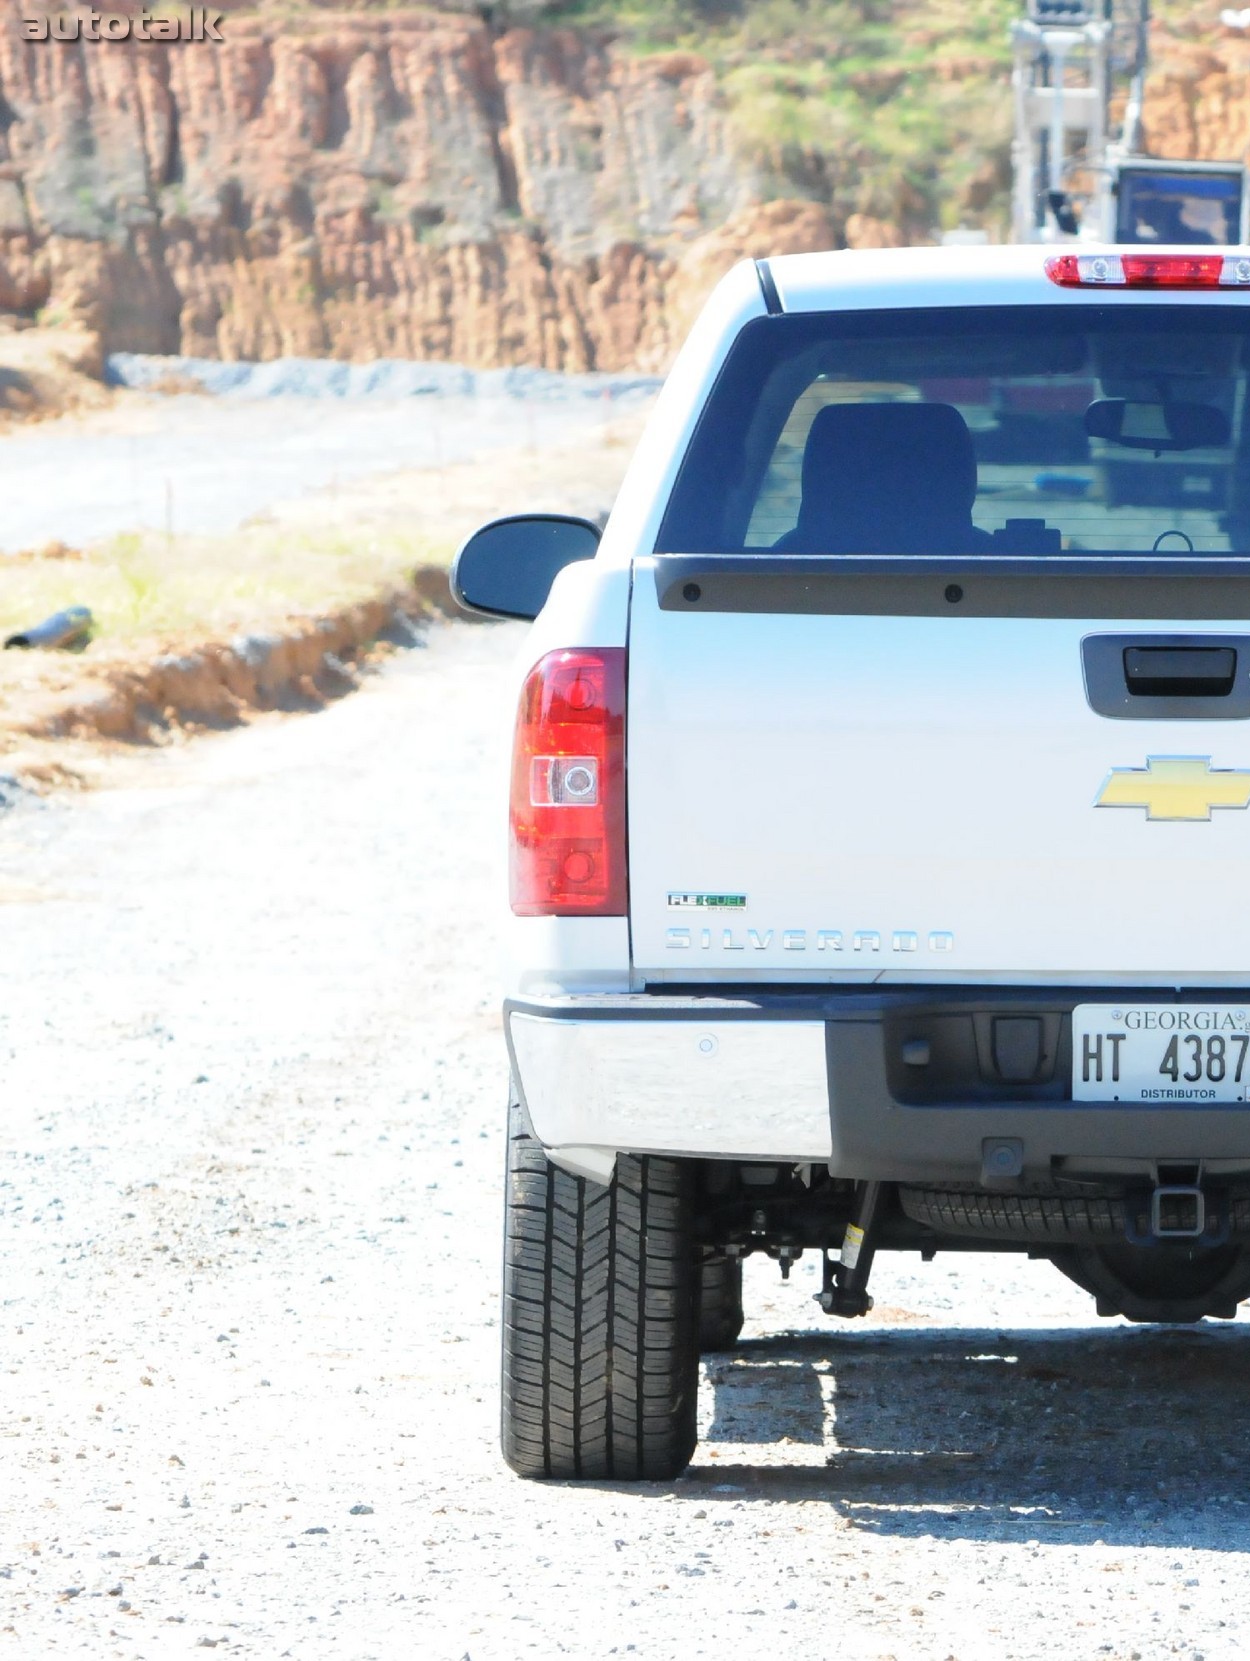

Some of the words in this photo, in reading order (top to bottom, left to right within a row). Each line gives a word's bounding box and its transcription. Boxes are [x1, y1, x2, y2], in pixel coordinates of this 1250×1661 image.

[666, 928, 954, 952] SILVERADO
[1082, 1034, 1126, 1082] HT
[1141, 1089, 1216, 1099] DISTRIBUTOR
